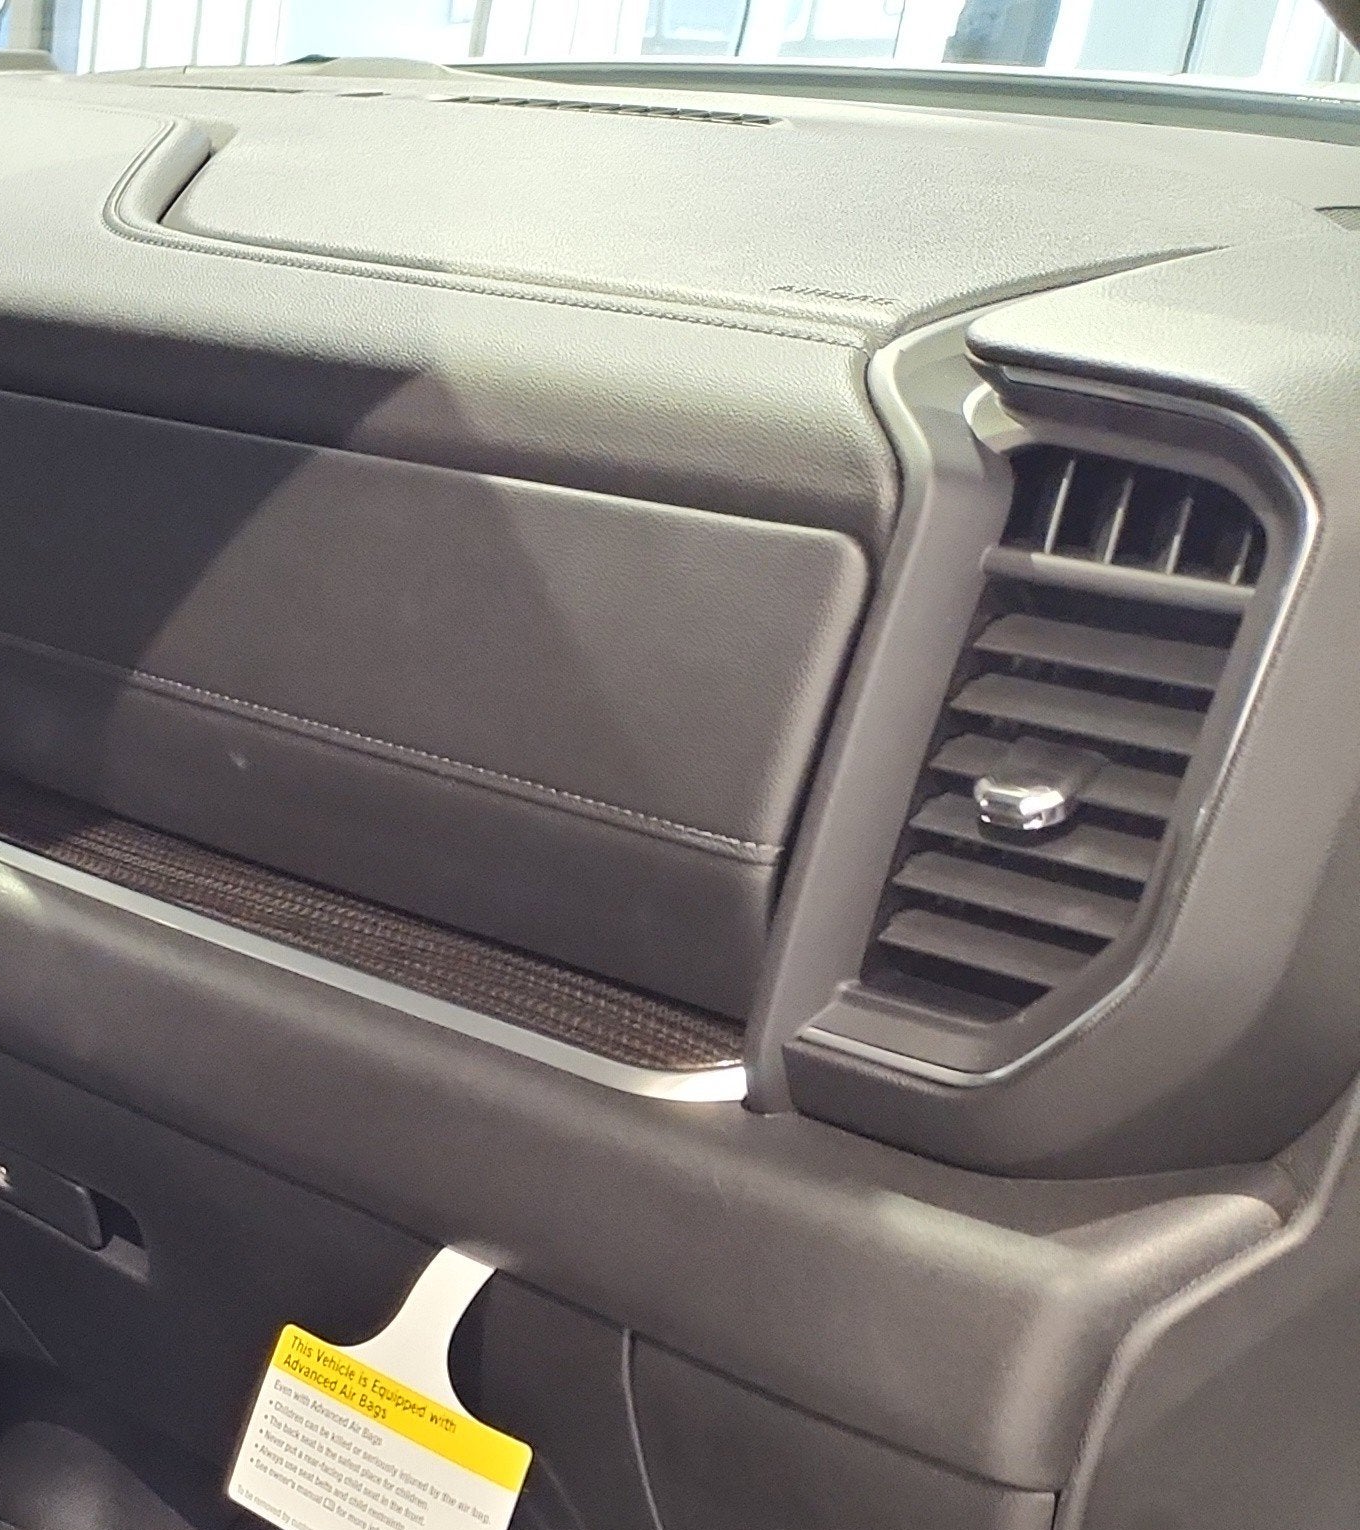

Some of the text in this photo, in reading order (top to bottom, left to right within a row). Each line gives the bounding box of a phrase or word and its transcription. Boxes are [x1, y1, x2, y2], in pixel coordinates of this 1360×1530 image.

[283, 1353, 386, 1419] Advanced Air Bags
[291, 1335, 456, 1433] This Vehicle is Equipped with
[269, 1414, 282, 1430] The
[300, 1434, 317, 1449] seat
[324, 1446, 337, 1460] the
[273, 1378, 383, 1446] Even with Advanced Air Bags
[273, 1400, 304, 1425] Children
[304, 1419, 319, 1432] can
[318, 1425, 330, 1439] be
[330, 1432, 353, 1451] killed
[352, 1445, 362, 1455] or
[258, 1444, 284, 1465] Always
[264, 1429, 285, 1448] Never
[254, 1458, 268, 1473] See
